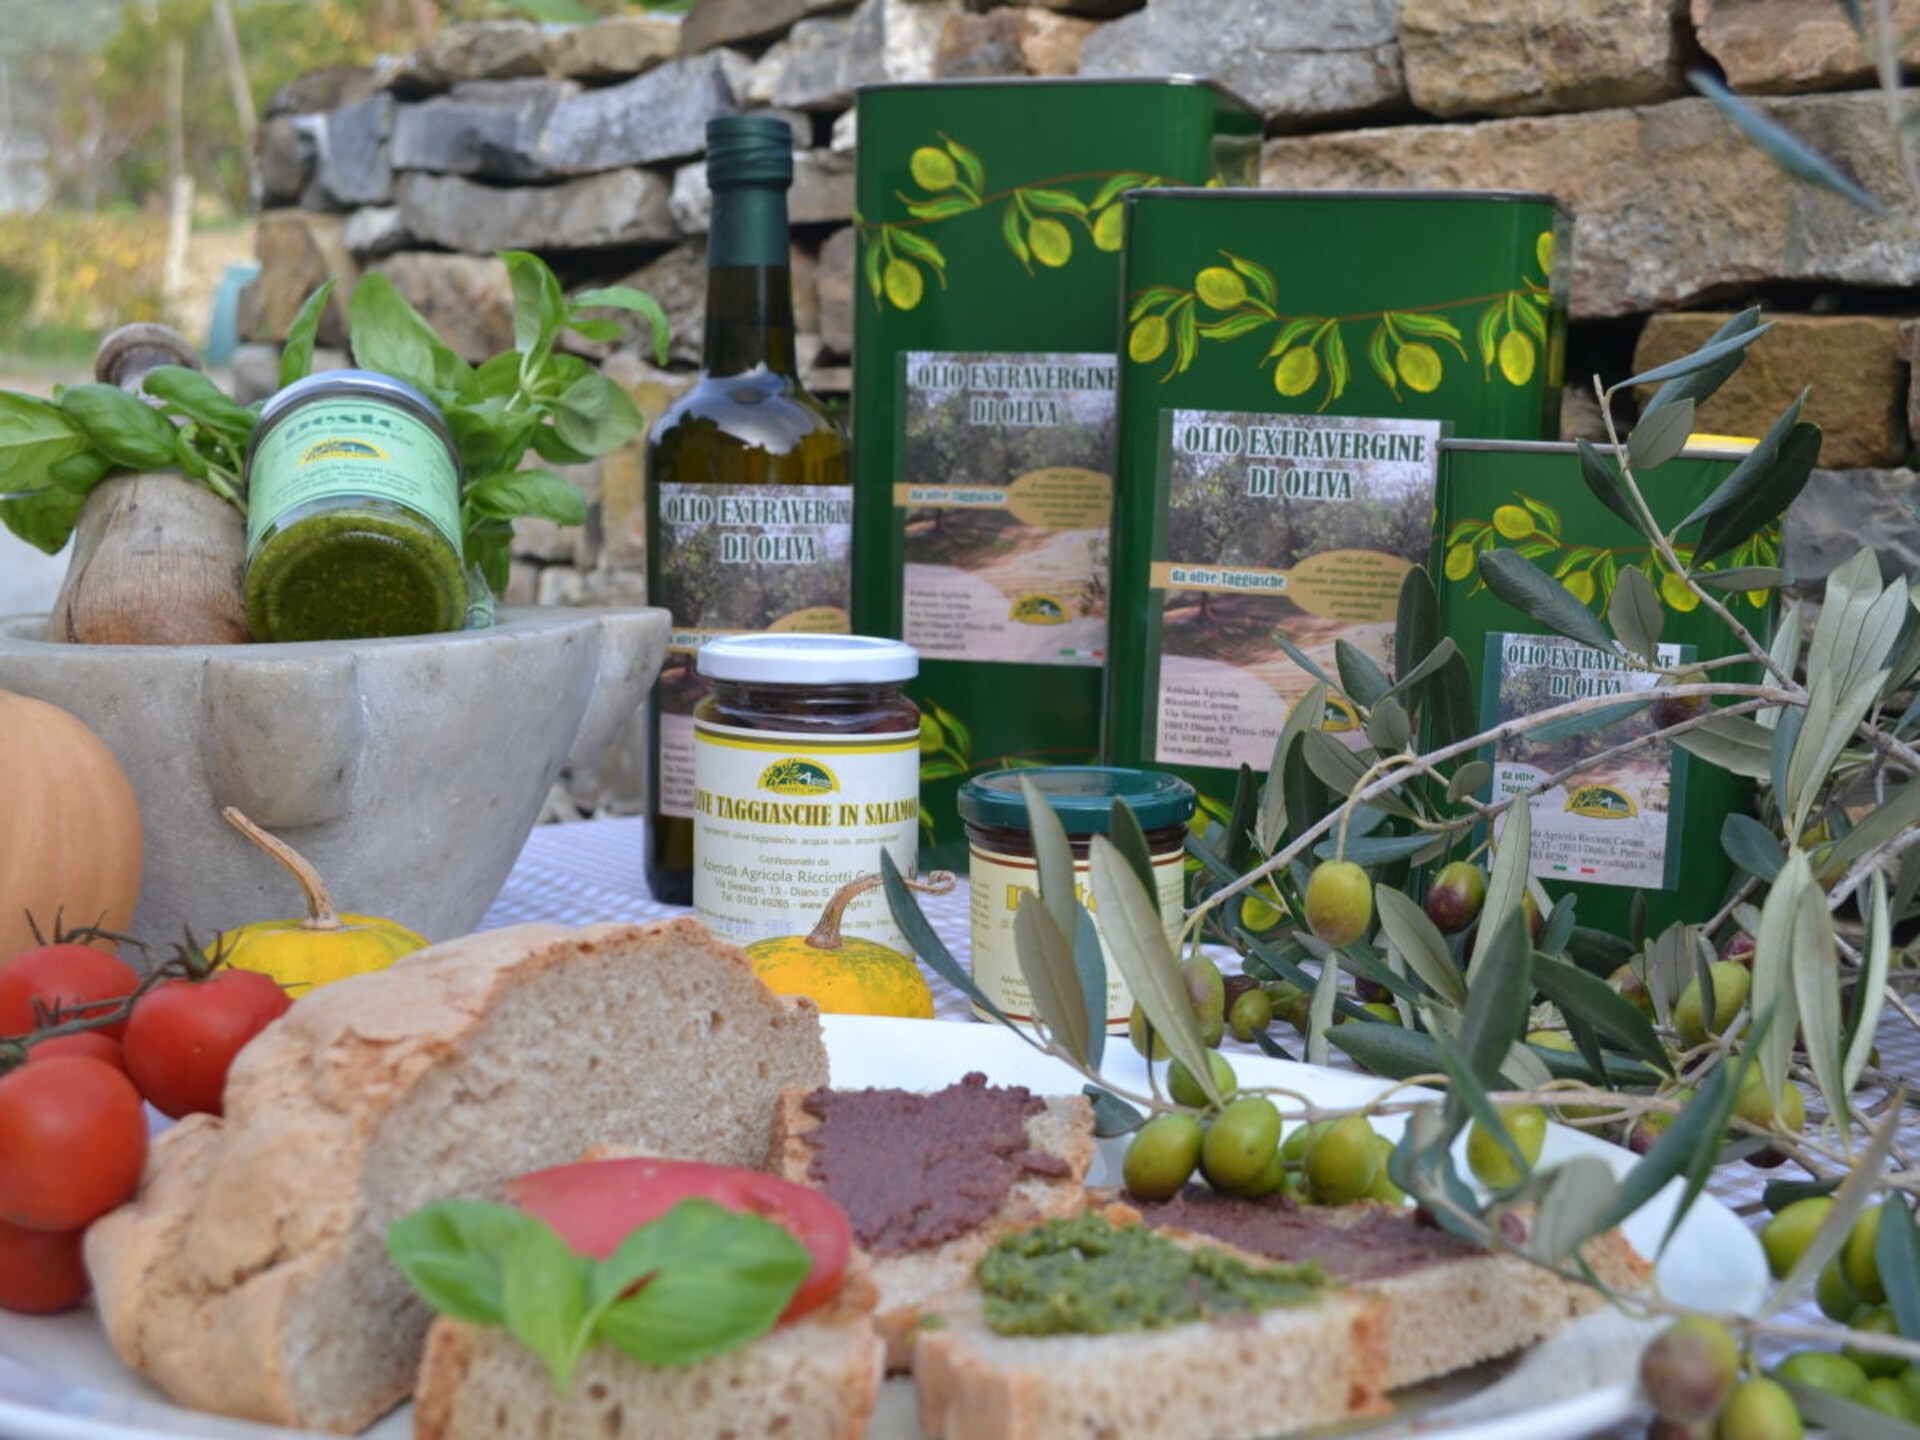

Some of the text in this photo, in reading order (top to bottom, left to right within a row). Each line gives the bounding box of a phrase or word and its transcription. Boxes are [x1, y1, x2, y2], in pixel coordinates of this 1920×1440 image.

[917, 365, 1116, 391] OLIO EXTRAVERGINE
[972, 399, 1059, 425] DI OLIVA
[1184, 426, 1426, 463] OLIO EXTRAVERGINE
[1250, 468, 1352, 499] DI OLIVA
[667, 497, 850, 524] OLIO EXTRAVERGIN
[723, 536, 816, 562] DI OLIVA
[1172, 569, 1285, 590] da olive Taggiasche
[1508, 645, 1545, 666] OLIO
[1552, 677, 1621, 697] DI OLIVA
[716, 796, 832, 826] TAGGIASCHE
[839, 805, 859, 826] IN
[741, 867, 793, 883] Agricola
[798, 871, 851, 884] Ricciotti
